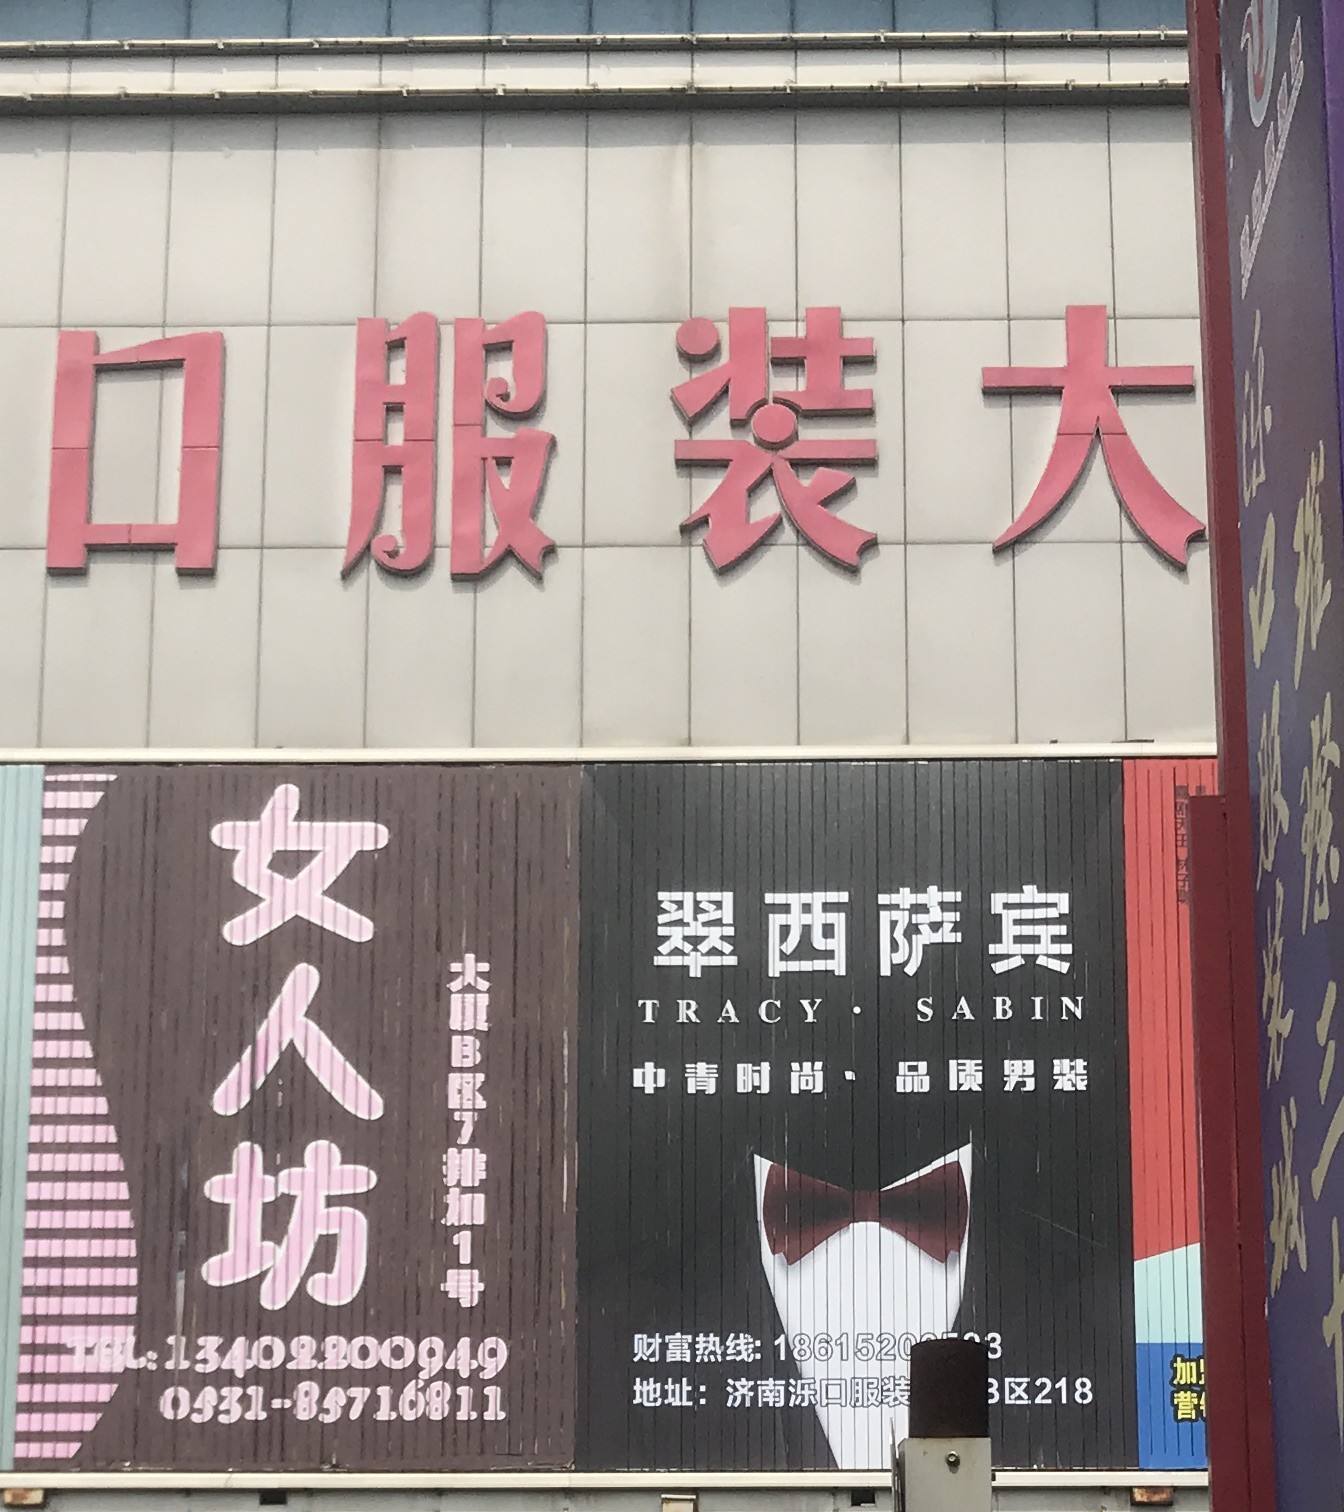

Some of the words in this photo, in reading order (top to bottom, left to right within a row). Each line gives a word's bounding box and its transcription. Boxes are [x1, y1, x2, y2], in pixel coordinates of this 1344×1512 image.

[653, 885, 1073, 977] 翠西萨宾
[916, 995, 1084, 1021] SABIN
[200, 783, 391, 1310] 女人坊
[159, 1380, 507, 1425] 0531-85716811
